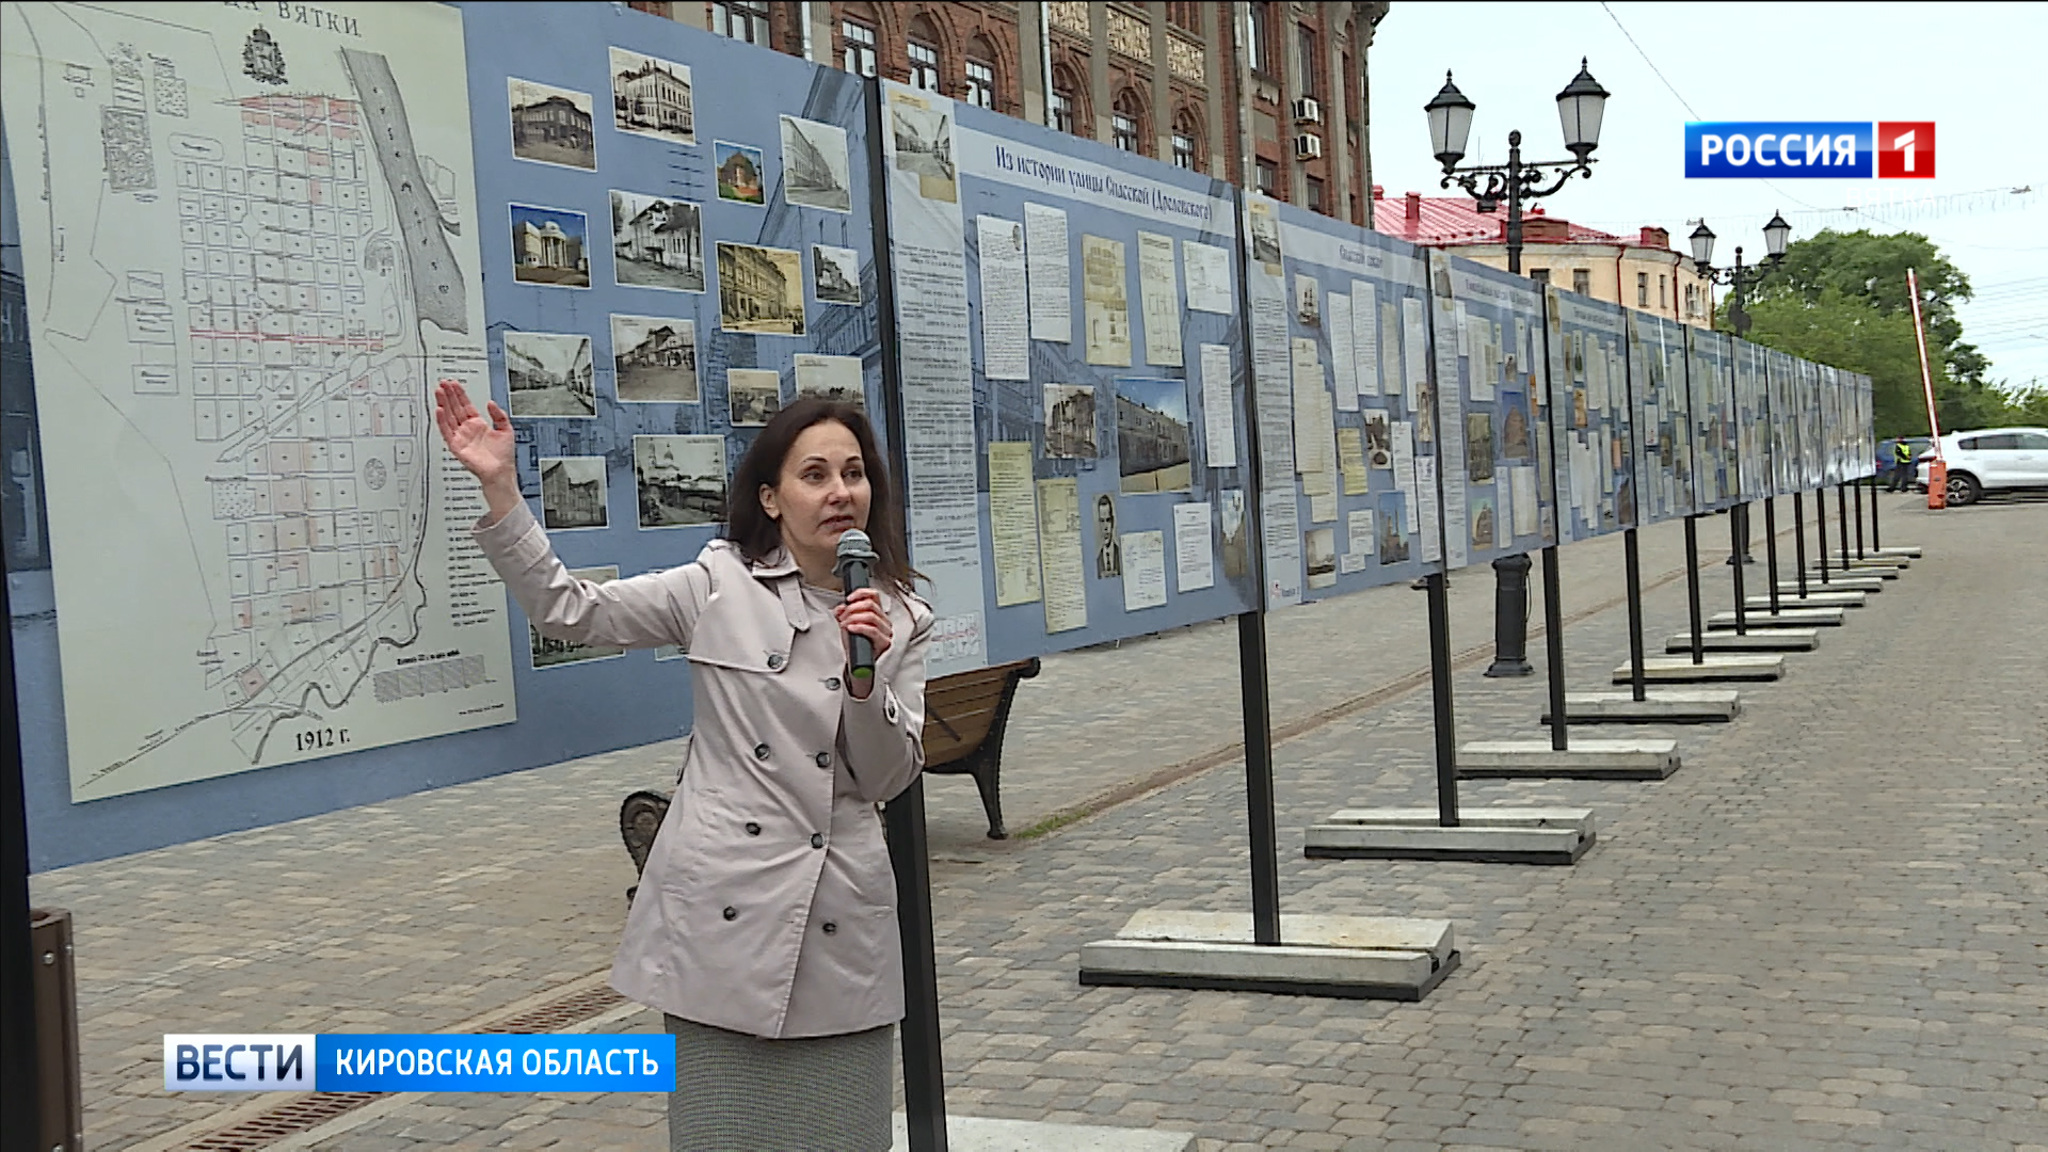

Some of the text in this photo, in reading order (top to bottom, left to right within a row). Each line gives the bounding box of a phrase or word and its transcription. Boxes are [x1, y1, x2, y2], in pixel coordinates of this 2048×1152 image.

[995, 145, 1014, 169] Из
[1017, 156, 1066, 188] истории
[1069, 169, 1103, 193] улицы
[296, 728, 351, 751] 1912 г.
